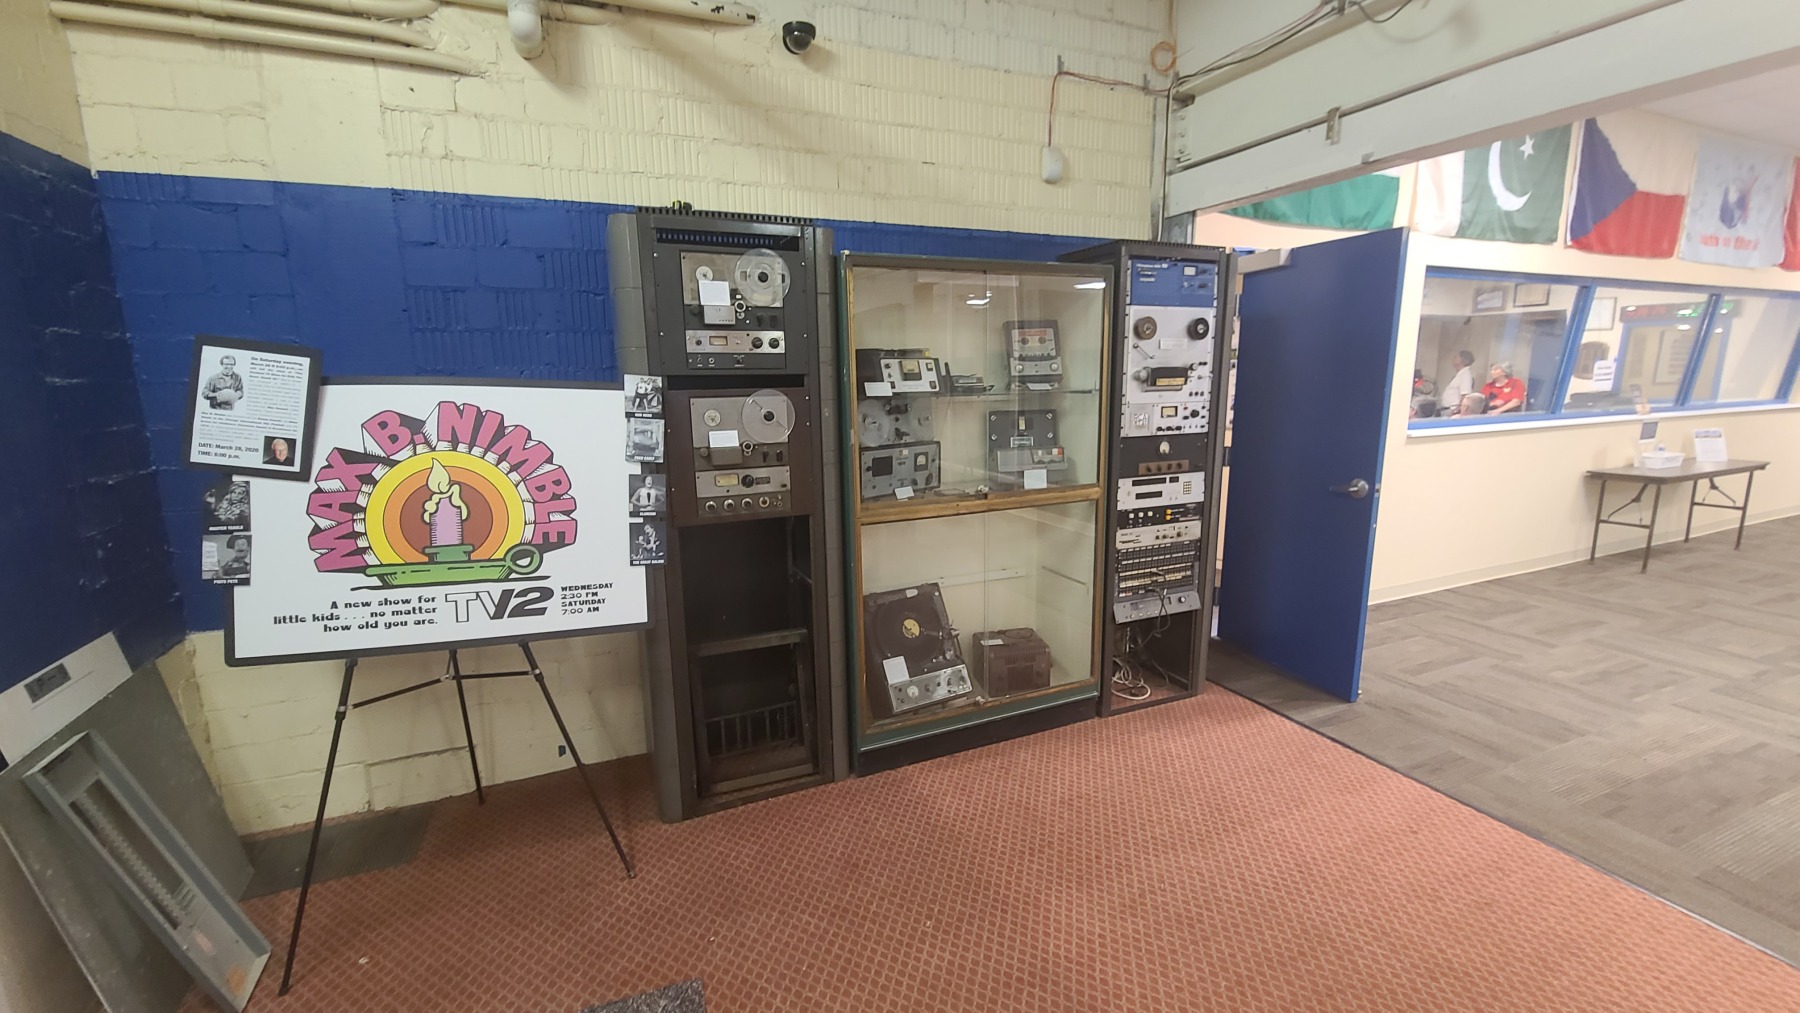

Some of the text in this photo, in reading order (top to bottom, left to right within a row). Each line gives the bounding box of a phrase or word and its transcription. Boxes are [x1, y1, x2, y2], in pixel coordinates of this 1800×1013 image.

[306, 400, 578, 573] MAX B. NIMBLE
[560, 582, 614, 592] WEDNESDAY
[330, 595, 437, 610] A new show for
[445, 586, 555, 623] TV2
[560, 598, 607, 608] SATURDAY
[273, 614, 307, 625] little
[370, 610, 386, 618] no
[391, 606, 438, 616] matter
[323, 617, 438, 632] how old you are.
